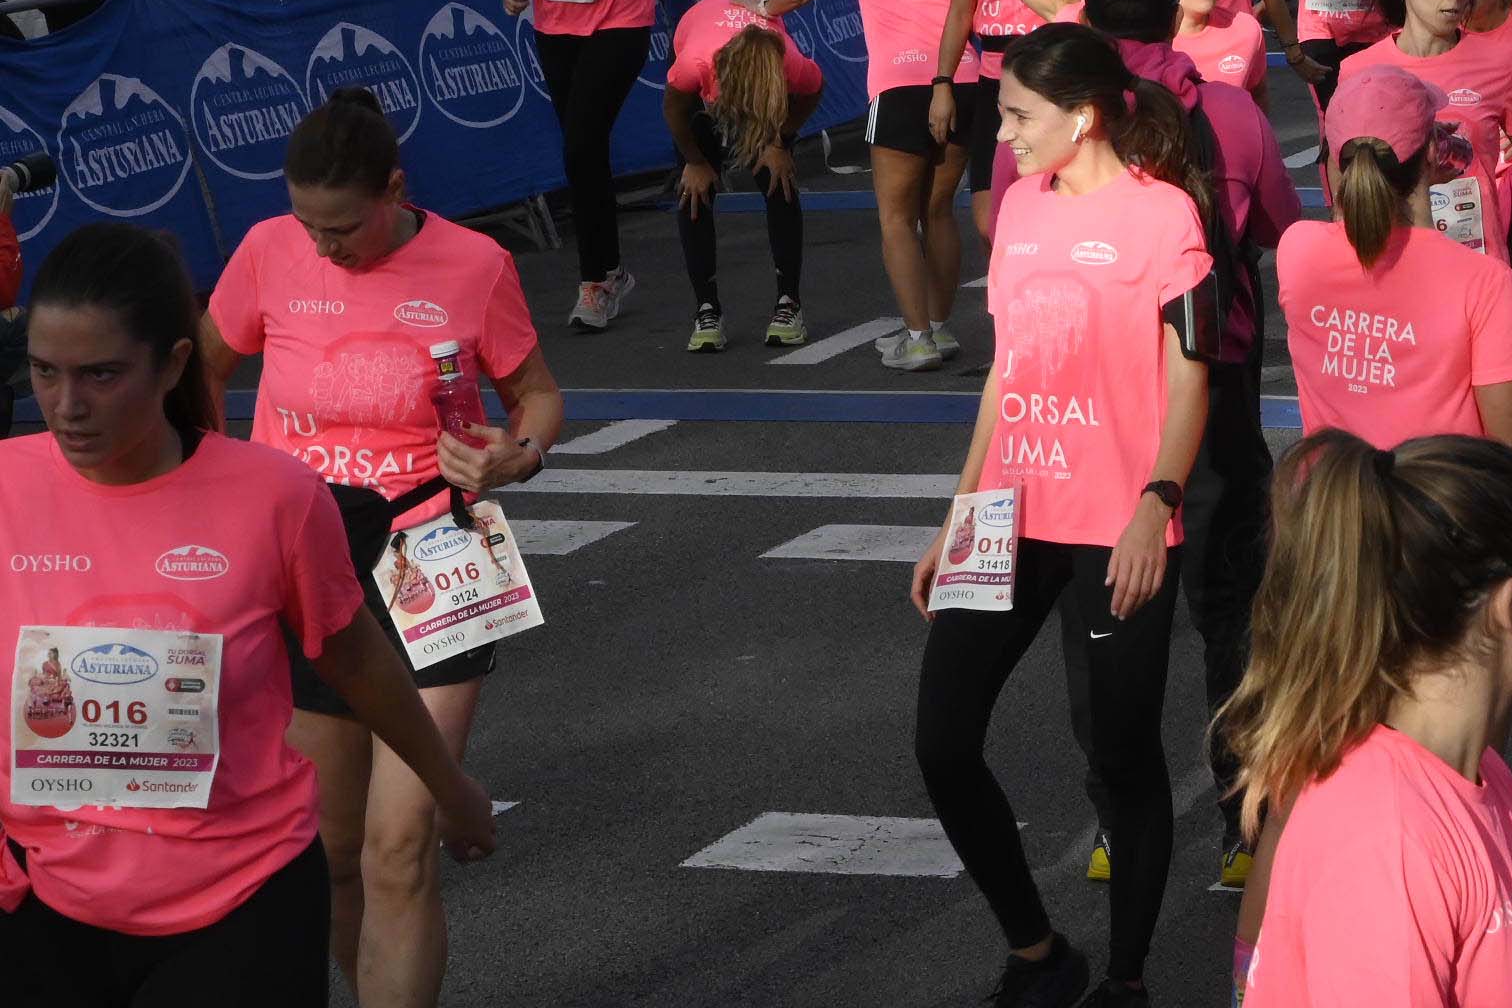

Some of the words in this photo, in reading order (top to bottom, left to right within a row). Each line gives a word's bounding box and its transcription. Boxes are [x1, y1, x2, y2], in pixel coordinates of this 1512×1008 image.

[893, 53, 928, 65] OYSHO
[429, 55, 521, 101] ASTURIANA
[204, 97, 303, 152] ASTURIANA
[288, 299, 345, 316] OYSHO
[398, 306, 444, 325] ASTURIANA
[1310, 305, 1416, 346] CARRERA
[1327, 331, 1355, 356] DE
[1364, 338, 1393, 363] LA
[1321, 355, 1396, 387] MUJER
[1348, 383, 1368, 394] 2023
[276, 407, 317, 437] TU
[419, 532, 469, 559] ASTURIANA
[10, 554, 92, 573] OYSHO
[161, 558, 224, 573] ASTURIANA
[978, 559, 1010, 570] 31418
[435, 561, 480, 591] 016
[451, 587, 479, 606] 9124
[939, 589, 975, 601] OYSHO
[419, 614, 458, 634] CARRERA
[457, 609, 469, 619] DE
[468, 607, 480, 616] LA
[479, 598, 502, 613] MUJER
[503, 592, 520, 604] 2023
[492, 609, 529, 629] Santander
[423, 631, 465, 655] OYSHO
[77, 658, 152, 677] ASTURIANA
[166, 655, 206, 666] SUMA
[82, 699, 148, 725] 016
[89, 731, 140, 748] 32321
[36, 754, 93, 765] CARRERA
[94, 756, 111, 765] DE
[112, 756, 127, 766] LA
[129, 757, 168, 767] MUJER
[172, 758, 198, 768] 2023
[31, 778, 93, 793] OYSHO
[142, 780, 198, 793] Santander
